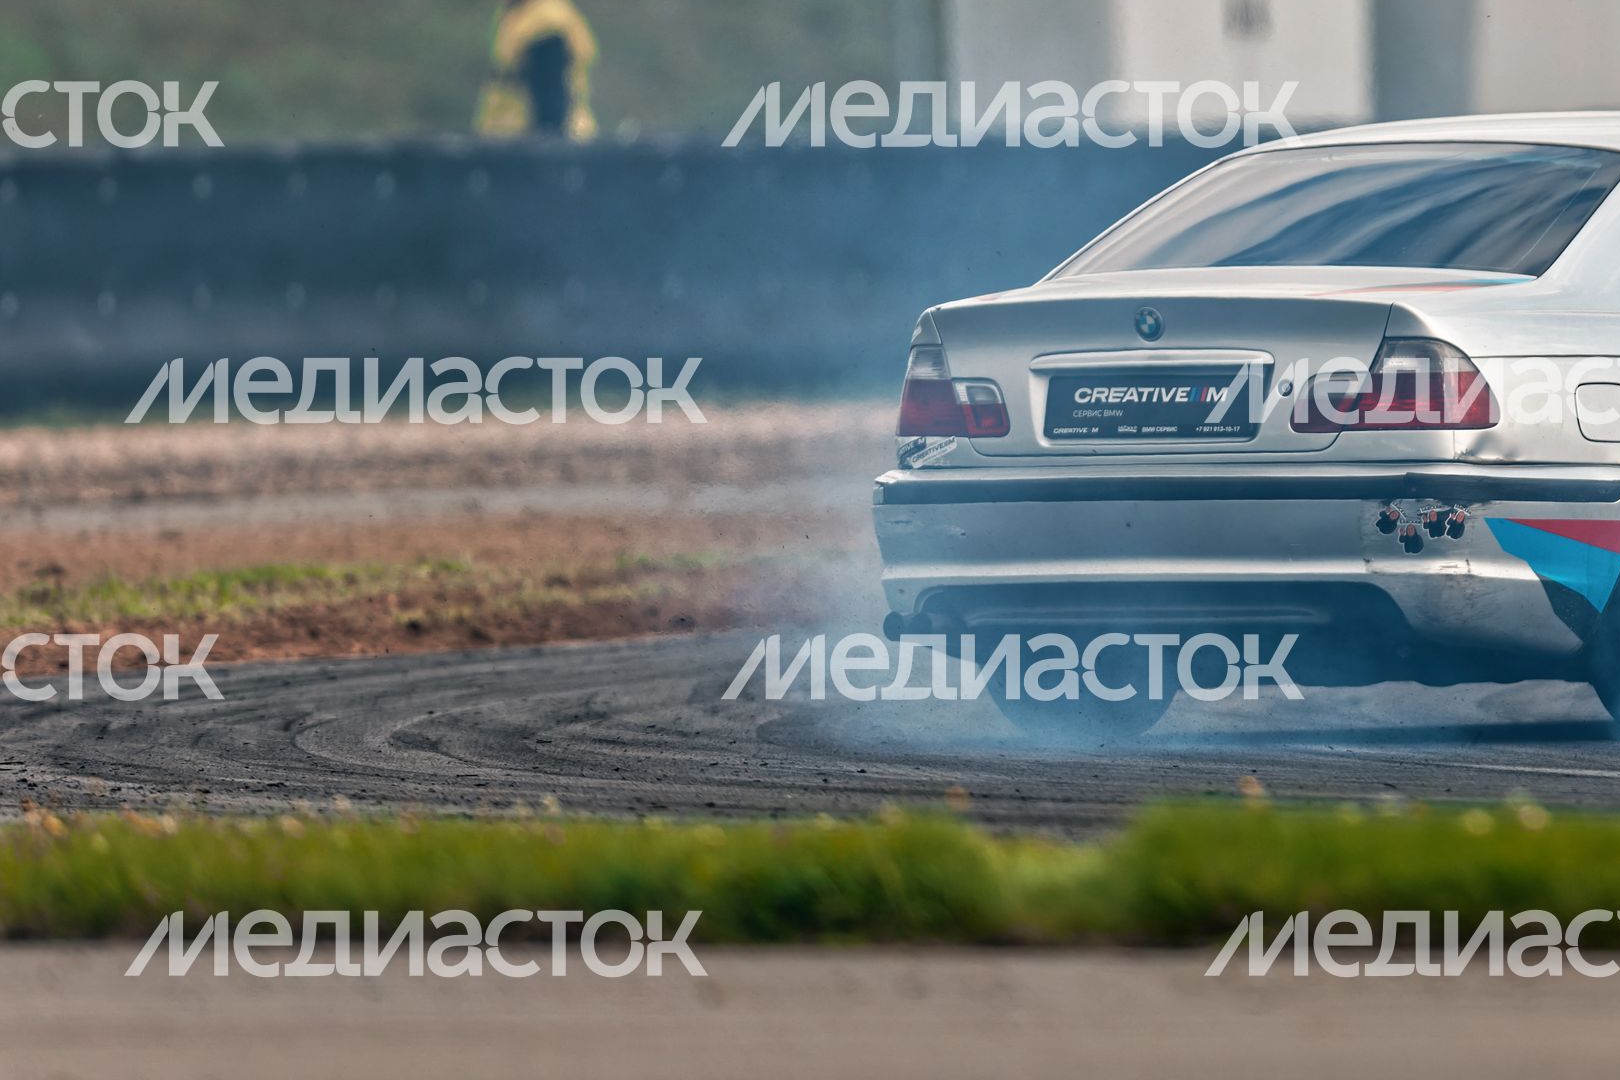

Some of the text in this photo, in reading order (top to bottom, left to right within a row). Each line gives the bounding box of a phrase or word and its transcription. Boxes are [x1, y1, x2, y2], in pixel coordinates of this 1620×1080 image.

[1074, 386, 1190, 404] CREATIVE
[1072, 409, 1124, 418] СЕРВИС BMW
